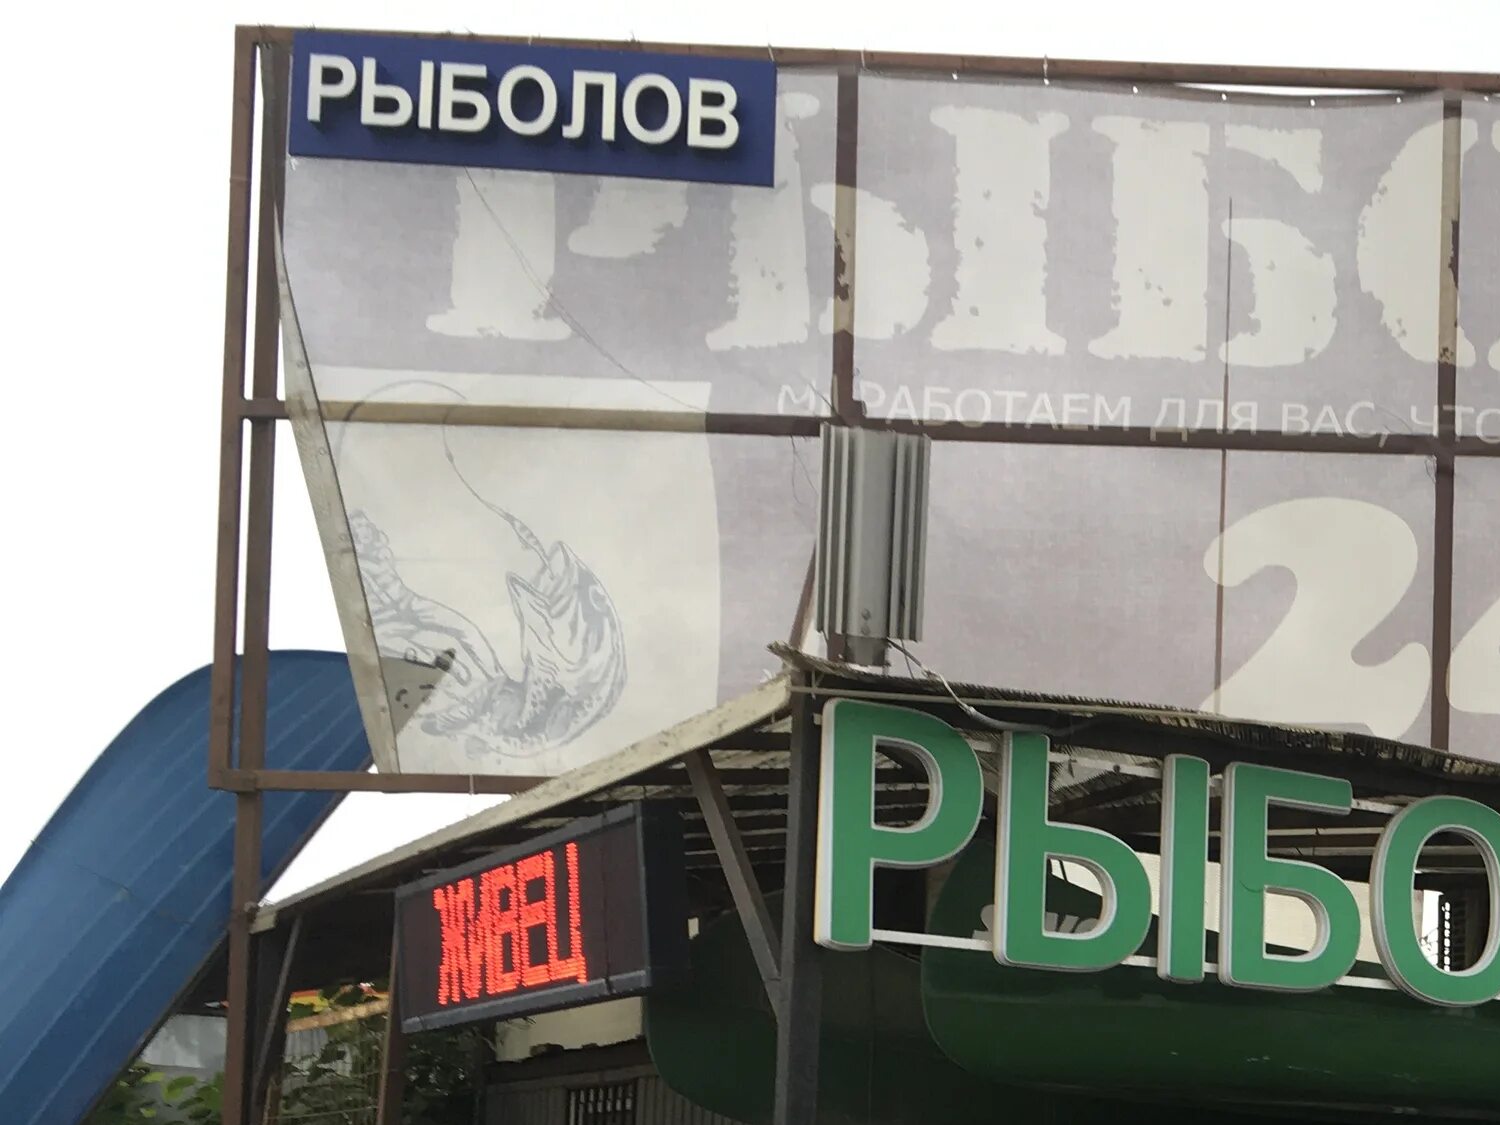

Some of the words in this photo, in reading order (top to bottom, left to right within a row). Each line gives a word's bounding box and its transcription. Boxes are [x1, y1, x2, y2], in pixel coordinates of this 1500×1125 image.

[306, 53, 741, 152] РЫБОЛОВ
[857, 381, 1132, 433] РАБОТАЕМ
[1148, 396, 1258, 443] ДЛЯ
[1281, 400, 1391, 448] ВАС,
[433, 841, 589, 1006] ЖИВЕЦ
